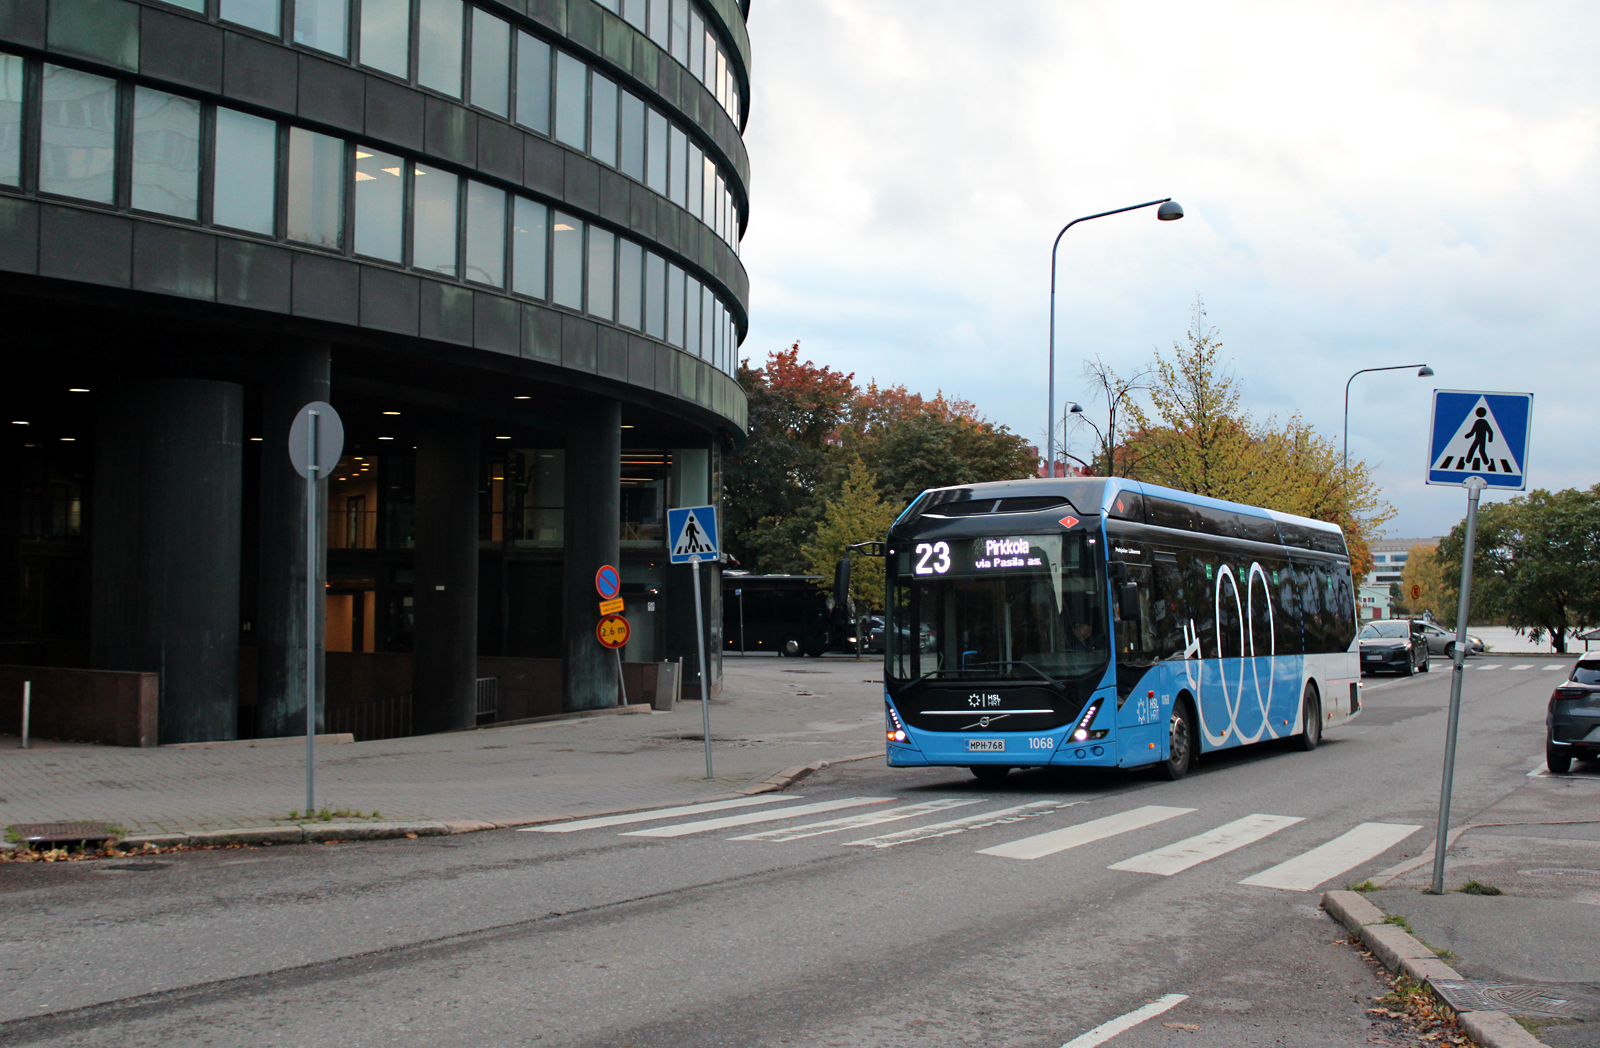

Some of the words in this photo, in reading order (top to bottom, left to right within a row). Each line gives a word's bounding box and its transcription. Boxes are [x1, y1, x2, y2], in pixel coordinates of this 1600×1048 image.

[985, 538, 1030, 556] Pirkkola
[915, 541, 951, 575] 23
[975, 559, 991, 569] via
[993, 557, 1025, 568] Pasila
[1027, 557, 1042, 566] as.
[601, 627, 616, 637] 2.6
[618, 627, 626, 635] m
[1150, 698, 1159, 709] HSL
[970, 741, 1003, 750] MPH-768
[1028, 737, 1054, 749] 1068
